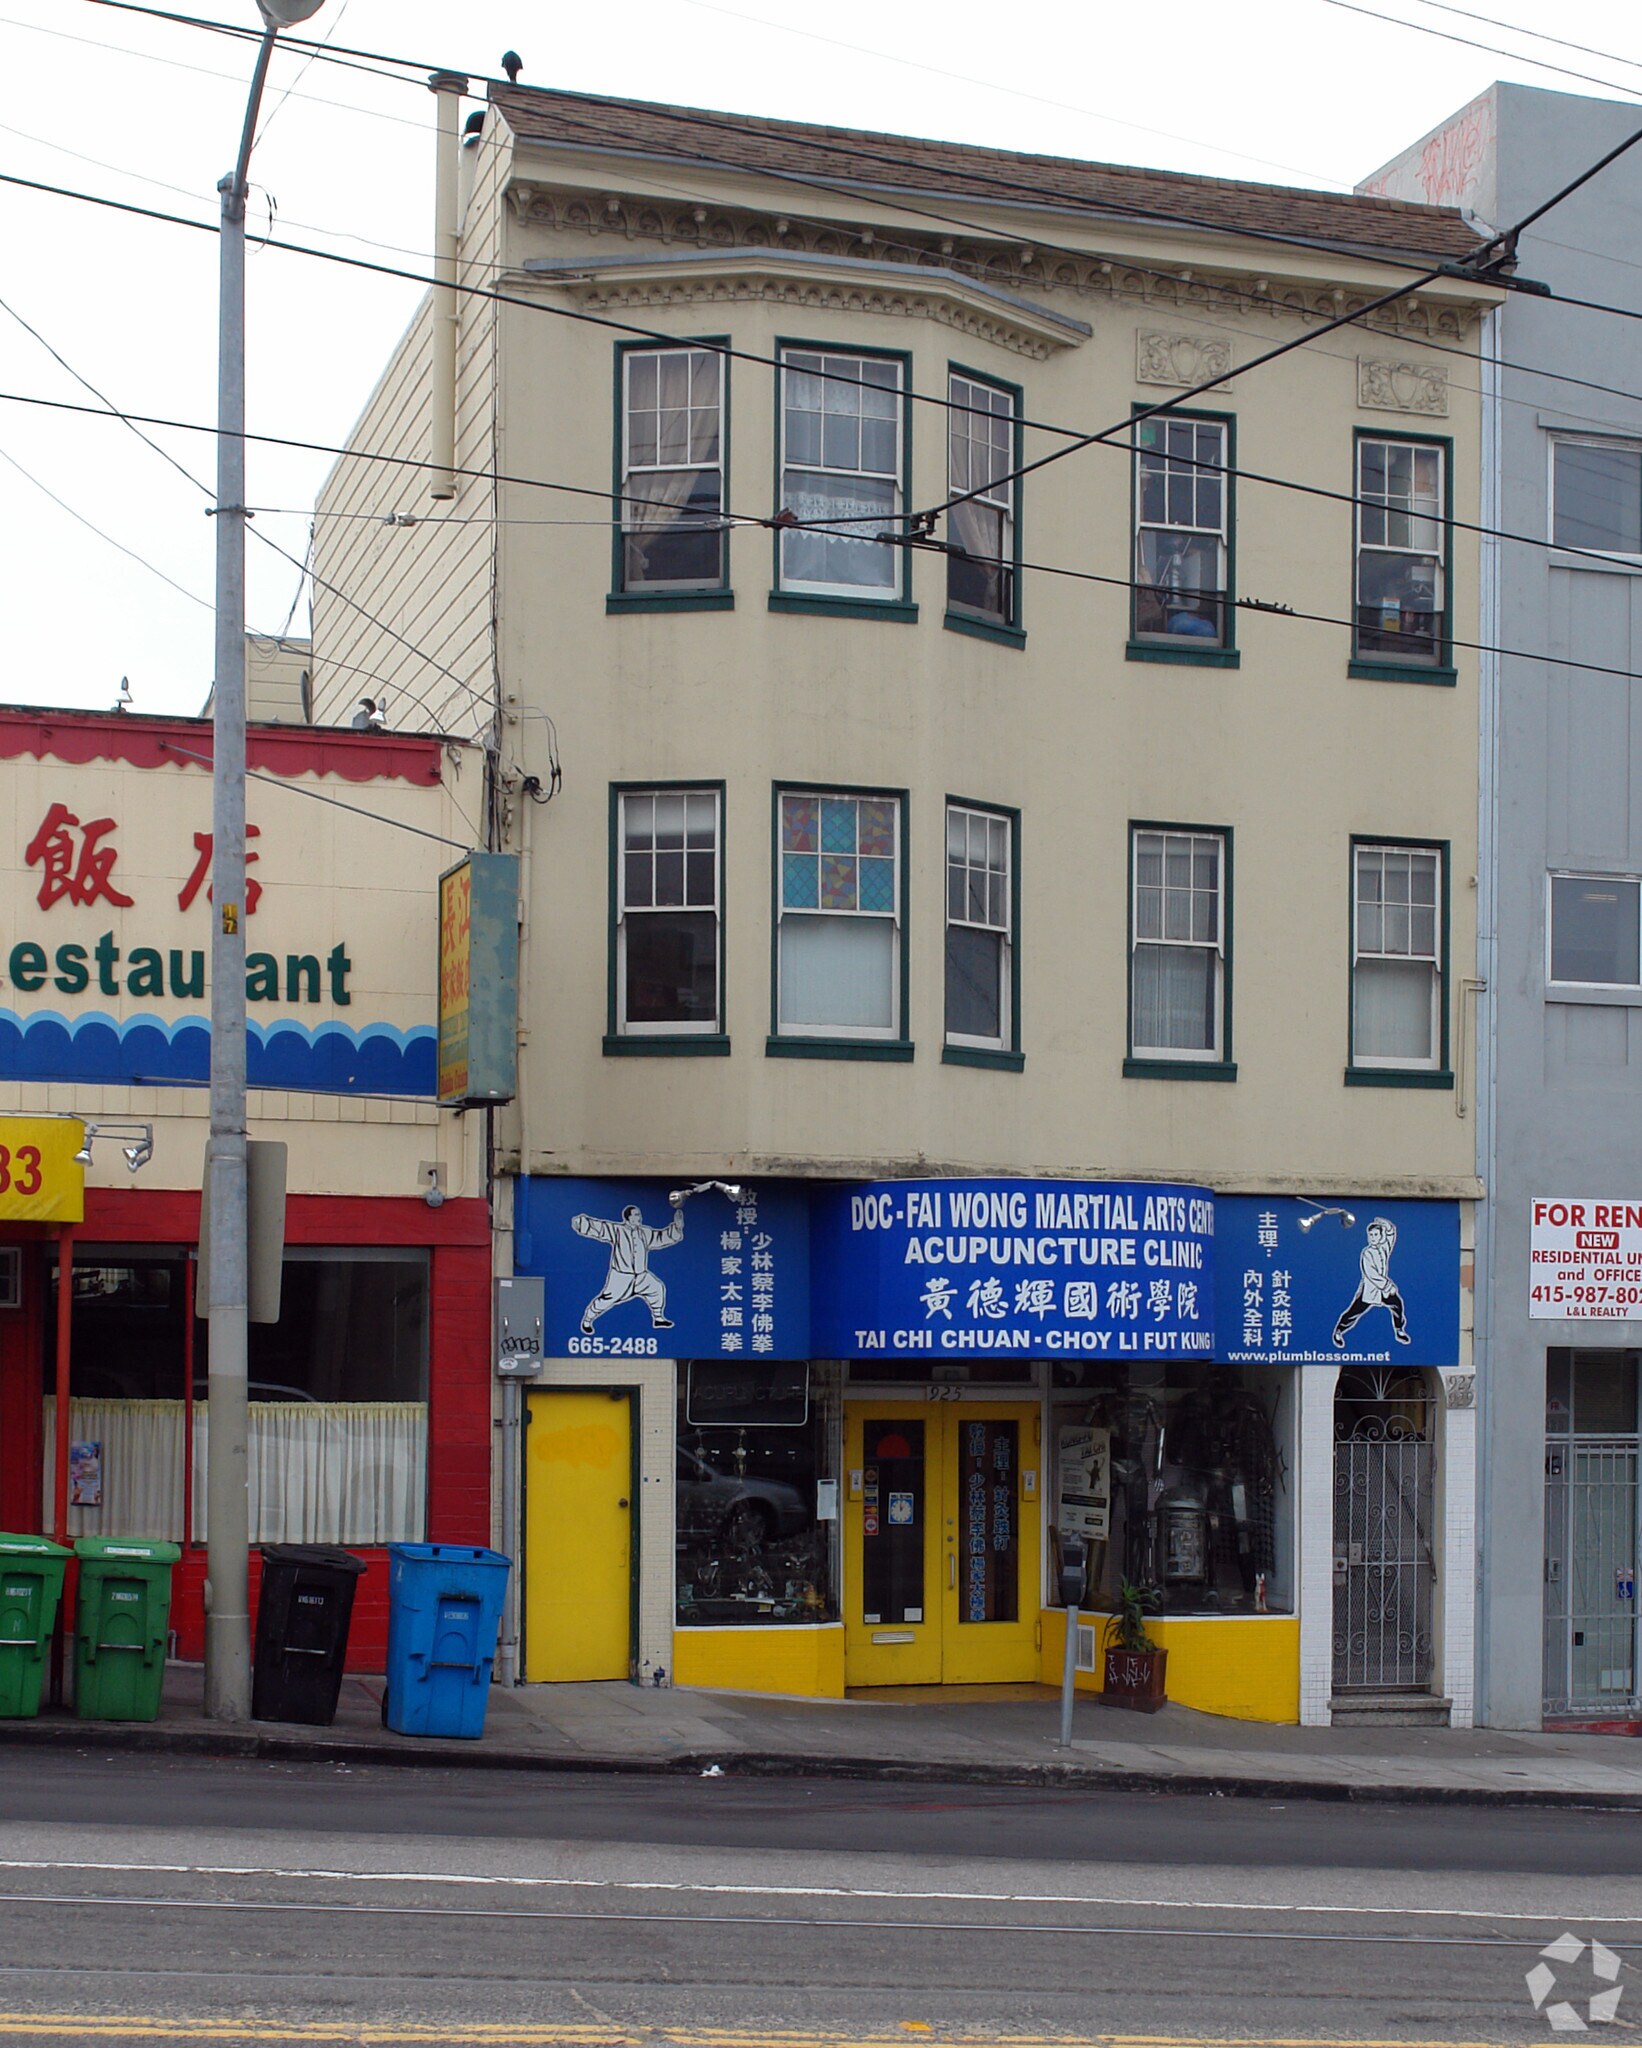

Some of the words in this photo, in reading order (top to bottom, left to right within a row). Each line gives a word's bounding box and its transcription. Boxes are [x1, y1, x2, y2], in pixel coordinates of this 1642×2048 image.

[949, 1192, 1027, 1230] WONG
[1035, 1193, 1139, 1231] MARTIAL
[1142, 1194, 1186, 1233] ARTS
[1534, 1203, 1586, 1227] FOR
[1581, 1233, 1615, 1248] NEW
[904, 1236, 1137, 1266] ACUPUNCTURE
[1143, 1238, 1204, 1270] CLINIC
[1532, 1250, 1623, 1265] RESIDENTIAL
[1557, 1268, 1585, 1281] and
[1593, 1269, 1641, 1282] OFFICE
[720, 1231, 743, 1353] 楊家太極拳
[750, 1231, 774, 1353] 少林蔡李佛拳
[1271, 1269, 1293, 1348] 針灸跌打
[1566, 1306, 1587, 1316] L&L
[1590, 1307, 1629, 1317] REALTY
[567, 1337, 658, 1355] 665-2488
[854, 1330, 886, 1349] TAI
[892, 1330, 933, 1349] CHI
[1119, 1331, 1138, 1350] LI
[1143, 1331, 1178, 1350] FUT
[1180, 1331, 1211, 1351] KUNG
[1227, 1350, 1391, 1364] www.plumblossom.net
[1448, 1375, 1476, 1392] 927
[929, 1386, 962, 1402] 925
